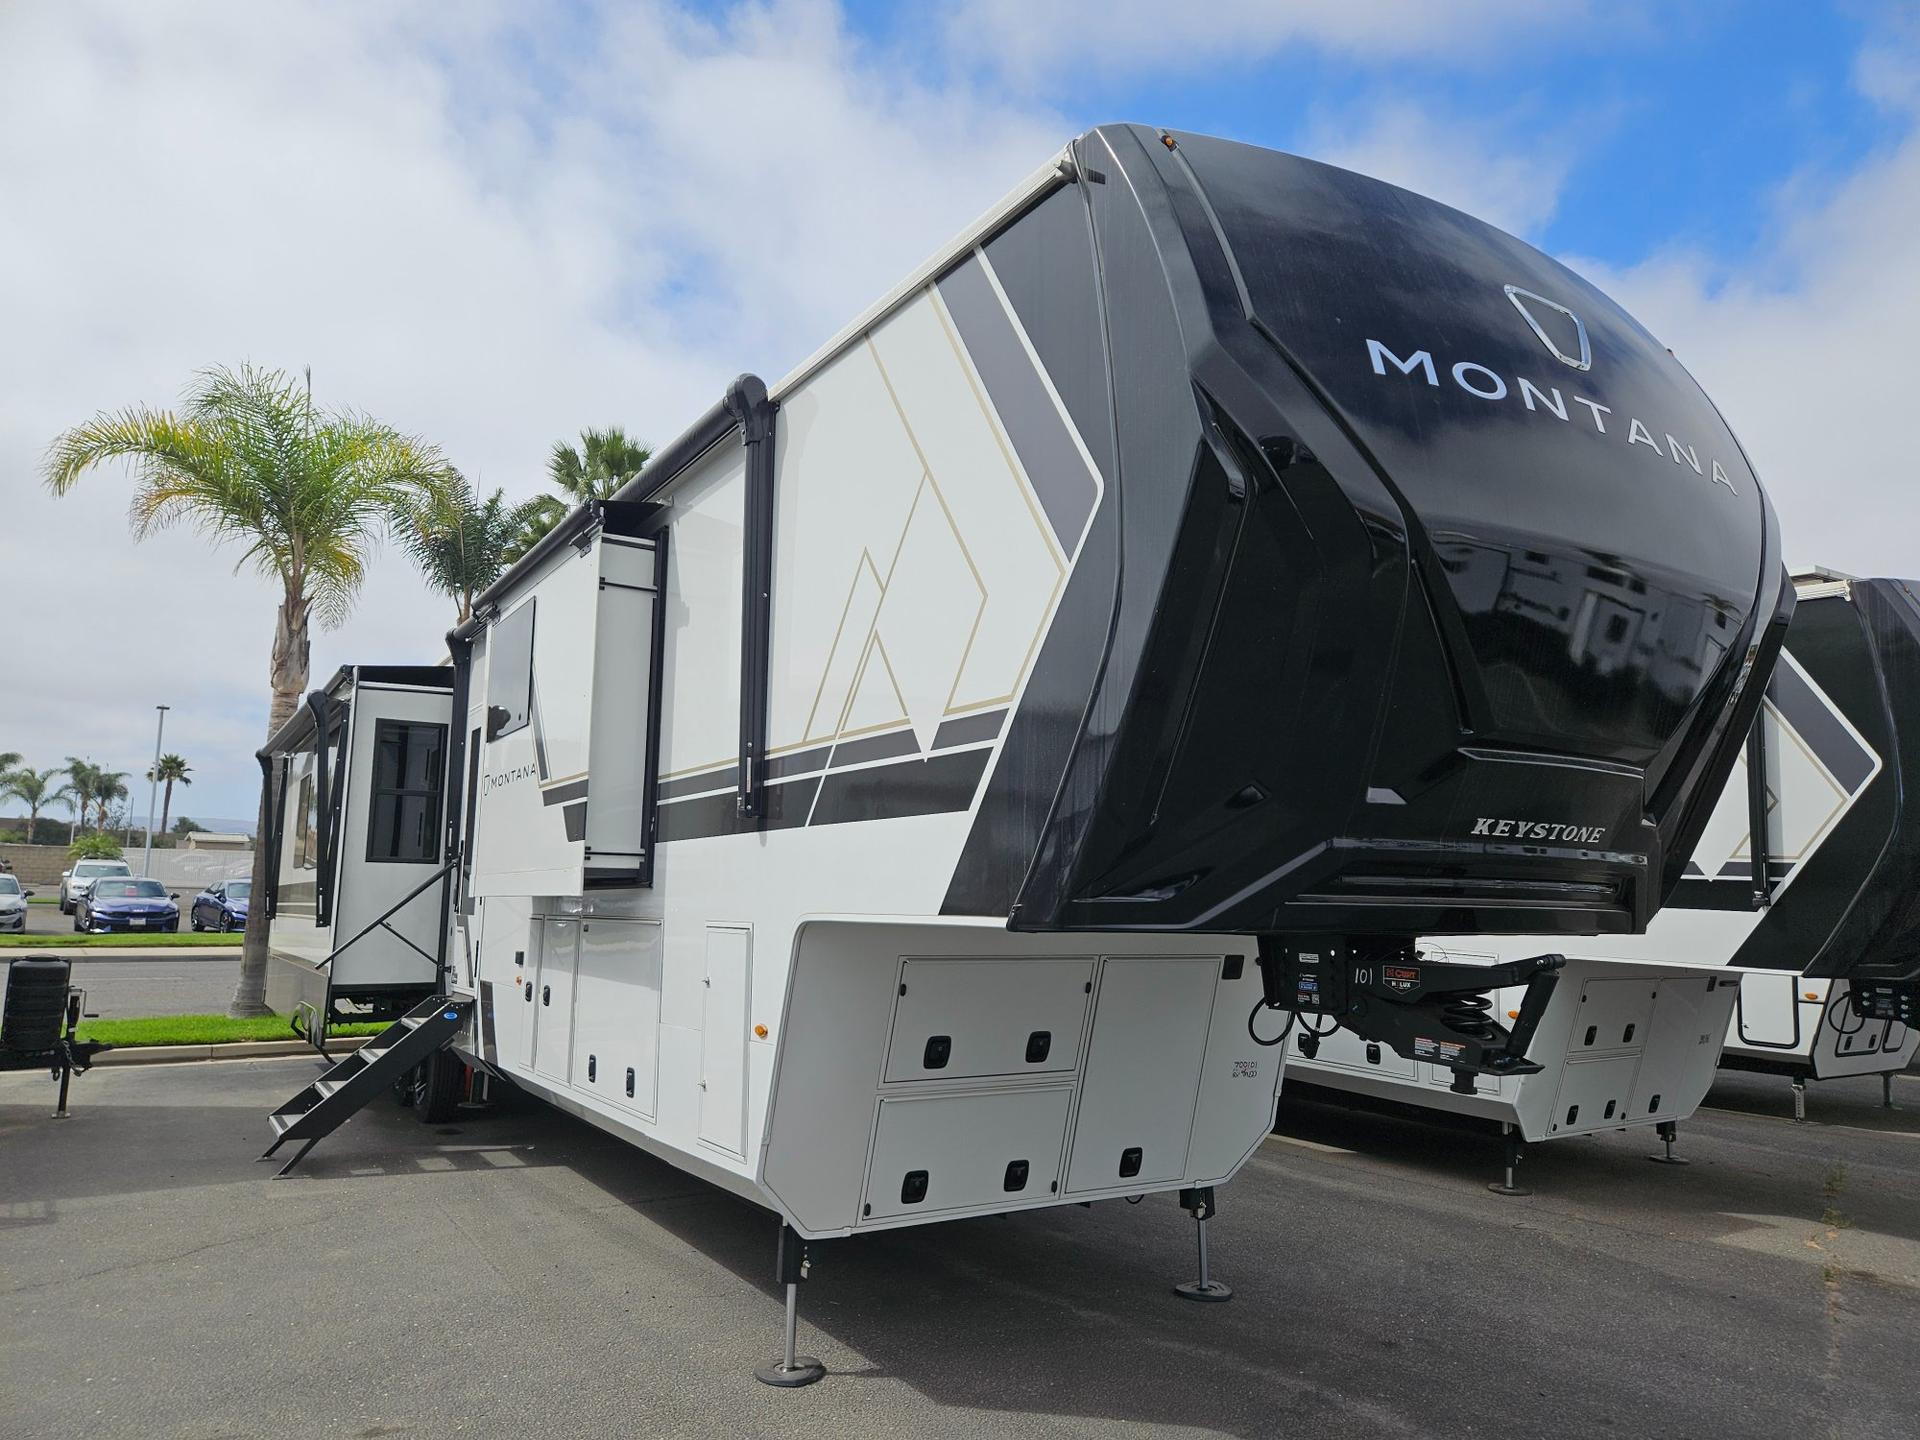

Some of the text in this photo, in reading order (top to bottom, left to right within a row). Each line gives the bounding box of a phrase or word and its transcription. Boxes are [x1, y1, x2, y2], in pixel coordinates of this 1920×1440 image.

[1366, 338, 1738, 496] MONTANA
[490, 763, 537, 789] MONTANA
[1470, 817, 1606, 843] KEYSTONE
[1354, 967, 1373, 986] 101
